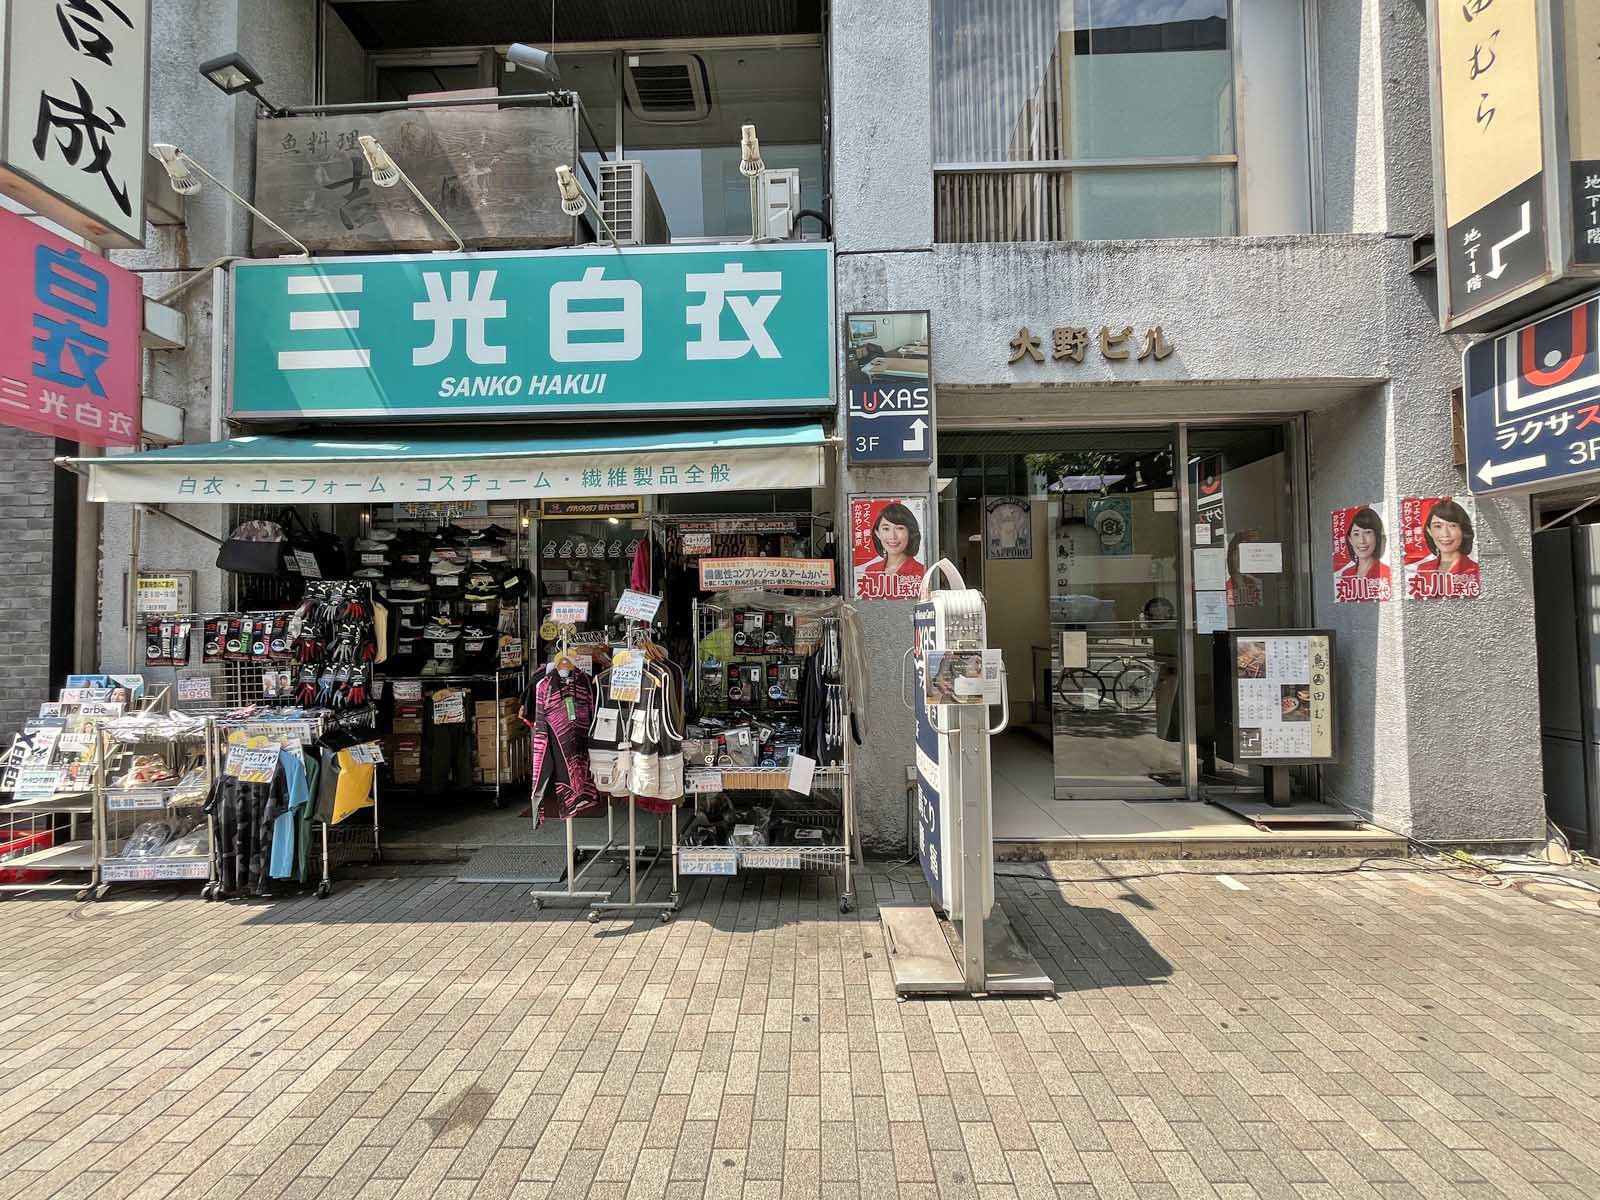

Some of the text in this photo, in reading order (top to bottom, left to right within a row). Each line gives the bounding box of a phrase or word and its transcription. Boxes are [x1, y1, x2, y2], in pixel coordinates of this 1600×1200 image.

[1463, 227, 1483, 293] 地下1階
[32, 243, 110, 399] 白衣
[278, 262, 783, 370] 三光白衣
[1008, 325, 1176, 364] 大野ビル
[438, 372, 607, 398] SANKO HAKUI
[849, 388, 929, 412] LUXAS
[1, 375, 135, 437] 三光白衣
[855, 436, 880, 453] 3F
[82, 704, 107, 714] arbe
